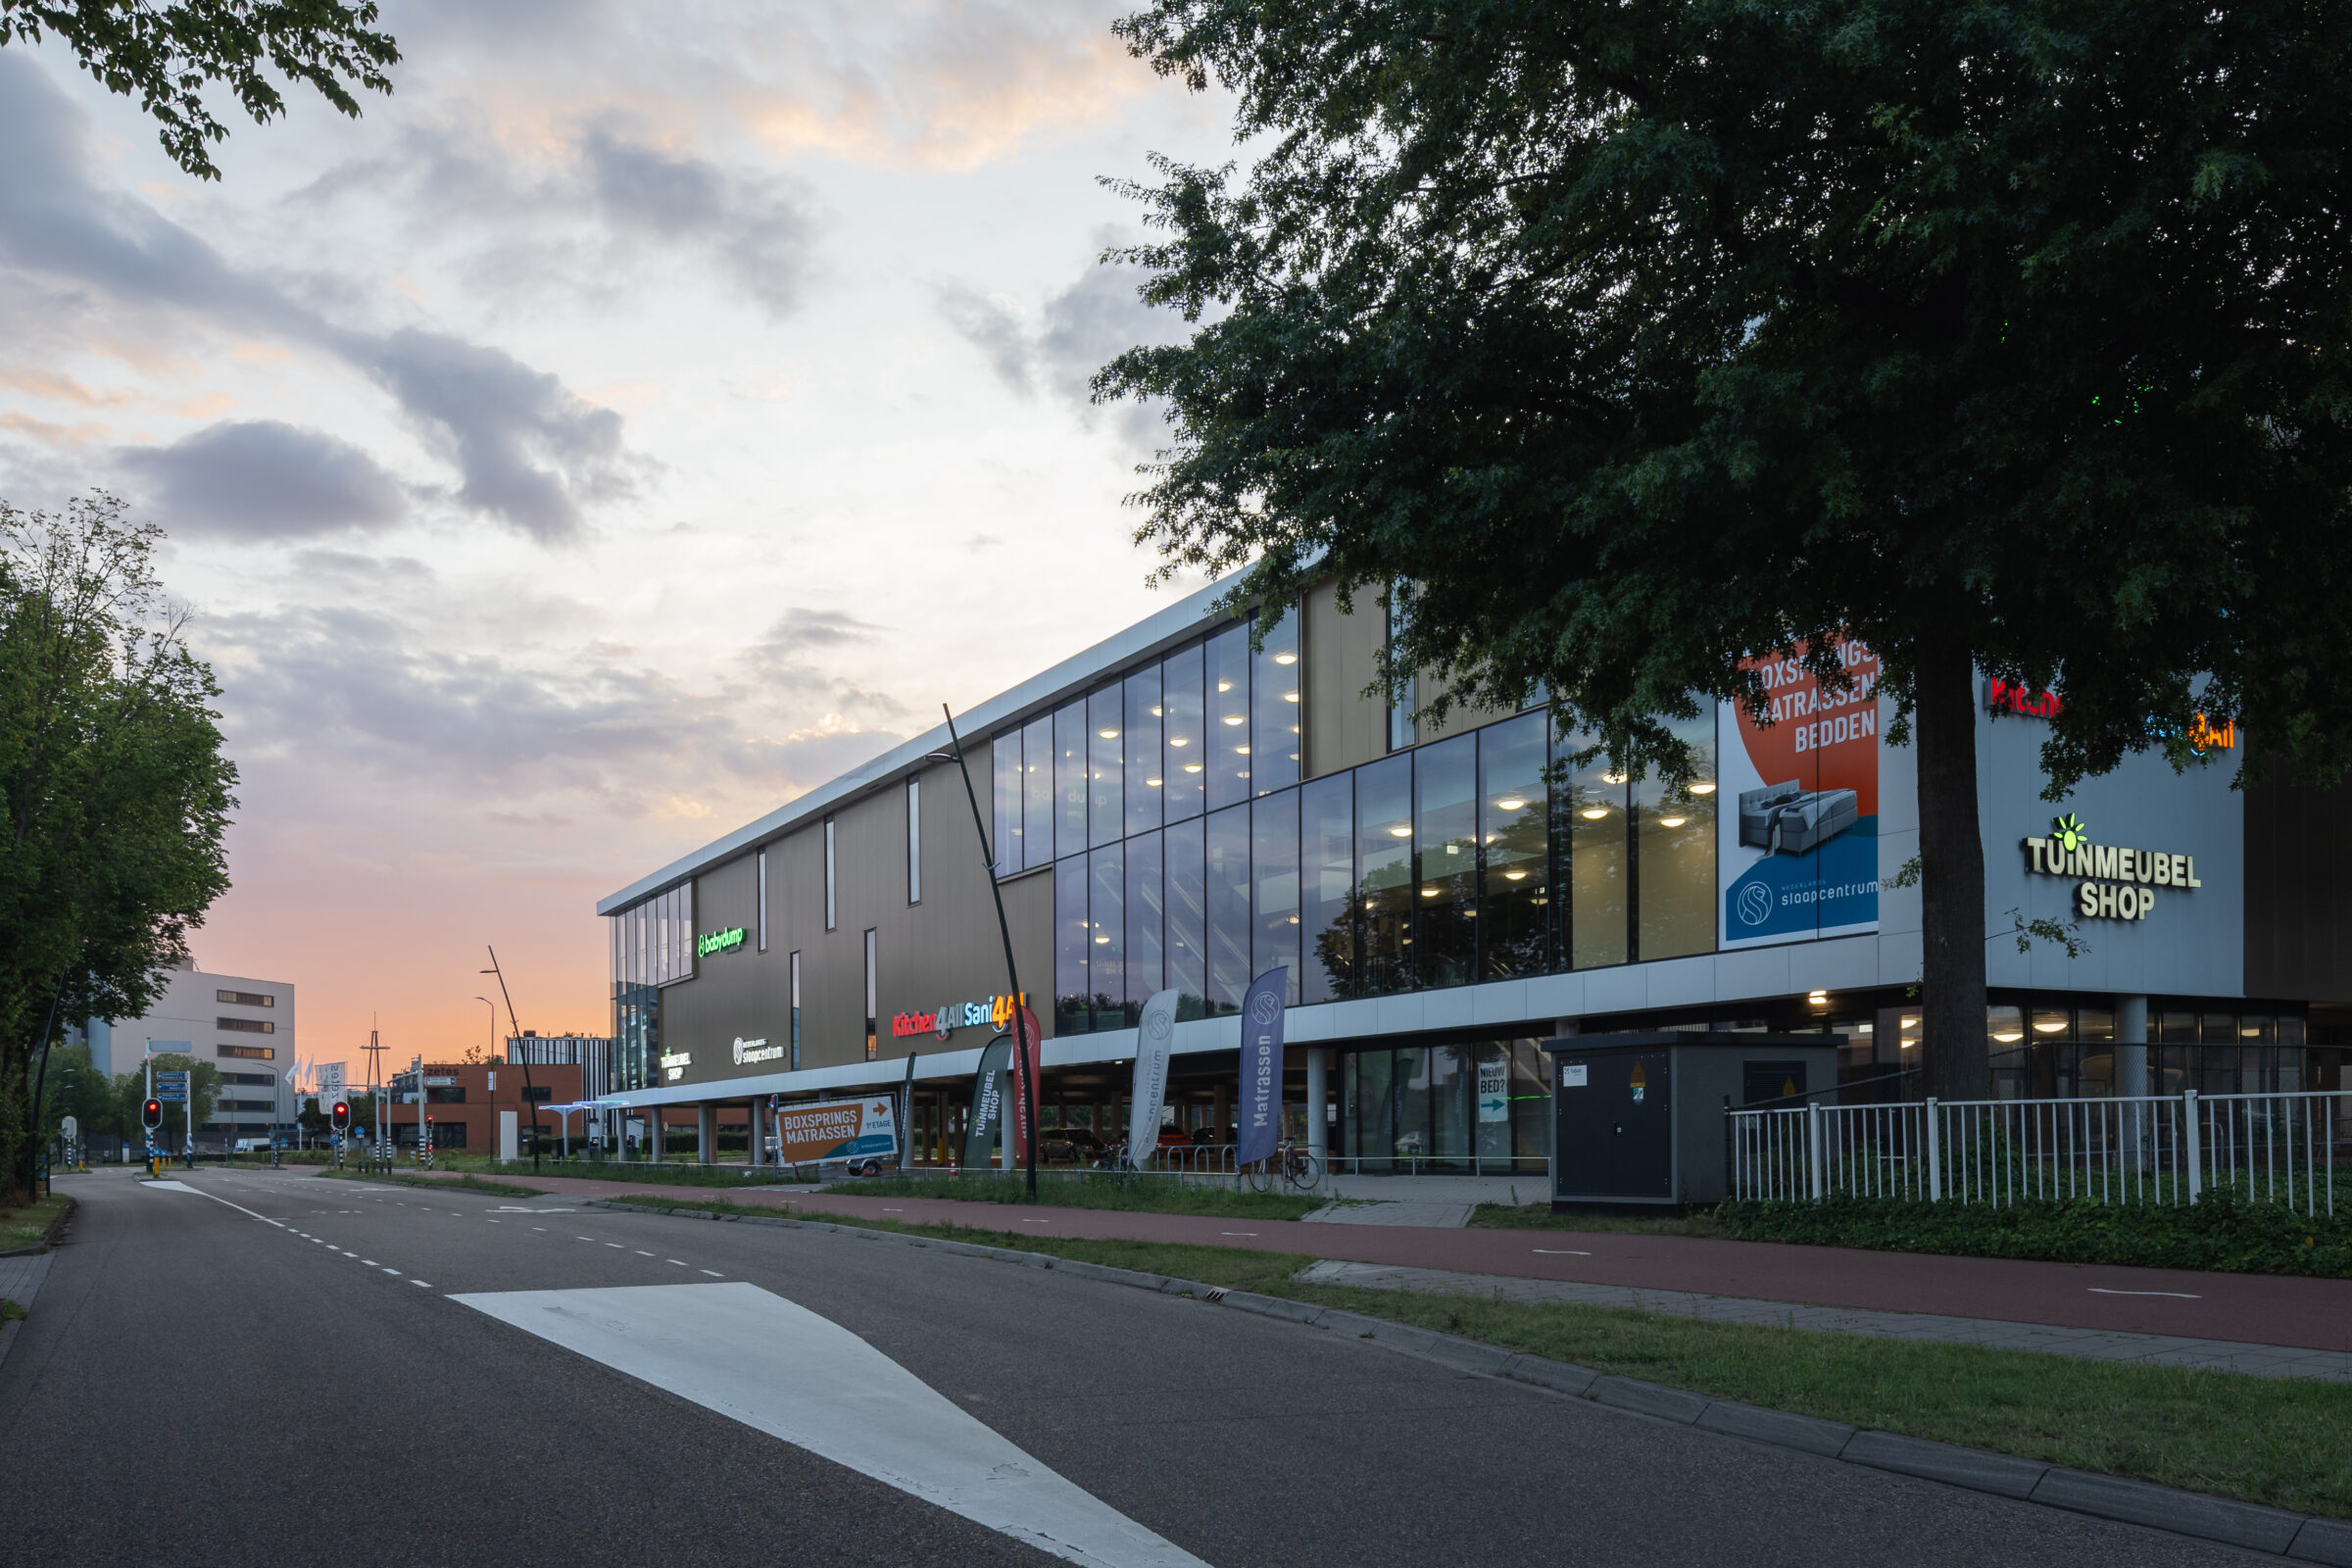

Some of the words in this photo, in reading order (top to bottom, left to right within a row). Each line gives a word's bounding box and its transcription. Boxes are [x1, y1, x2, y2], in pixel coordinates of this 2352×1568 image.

[1795, 709, 1875, 754] BEDDEN
[1782, 881, 1879, 906] slaapcentrum
[2081, 881, 2155, 920] SHOP
[705, 926, 744, 954] babydump
[427, 1066, 460, 1076] zetes
[1253, 1035, 1271, 1127] Matrassen
[1480, 1066, 1505, 1078] NIEUW
[1480, 1079, 1506, 1094] BED?
[987, 1090, 1000, 1120] SHOP
[784, 1109, 858, 1130] BOXSPRINGS
[872, 1119, 892, 1129] ETAGE
[786, 1124, 856, 1145] MATRASSEN
